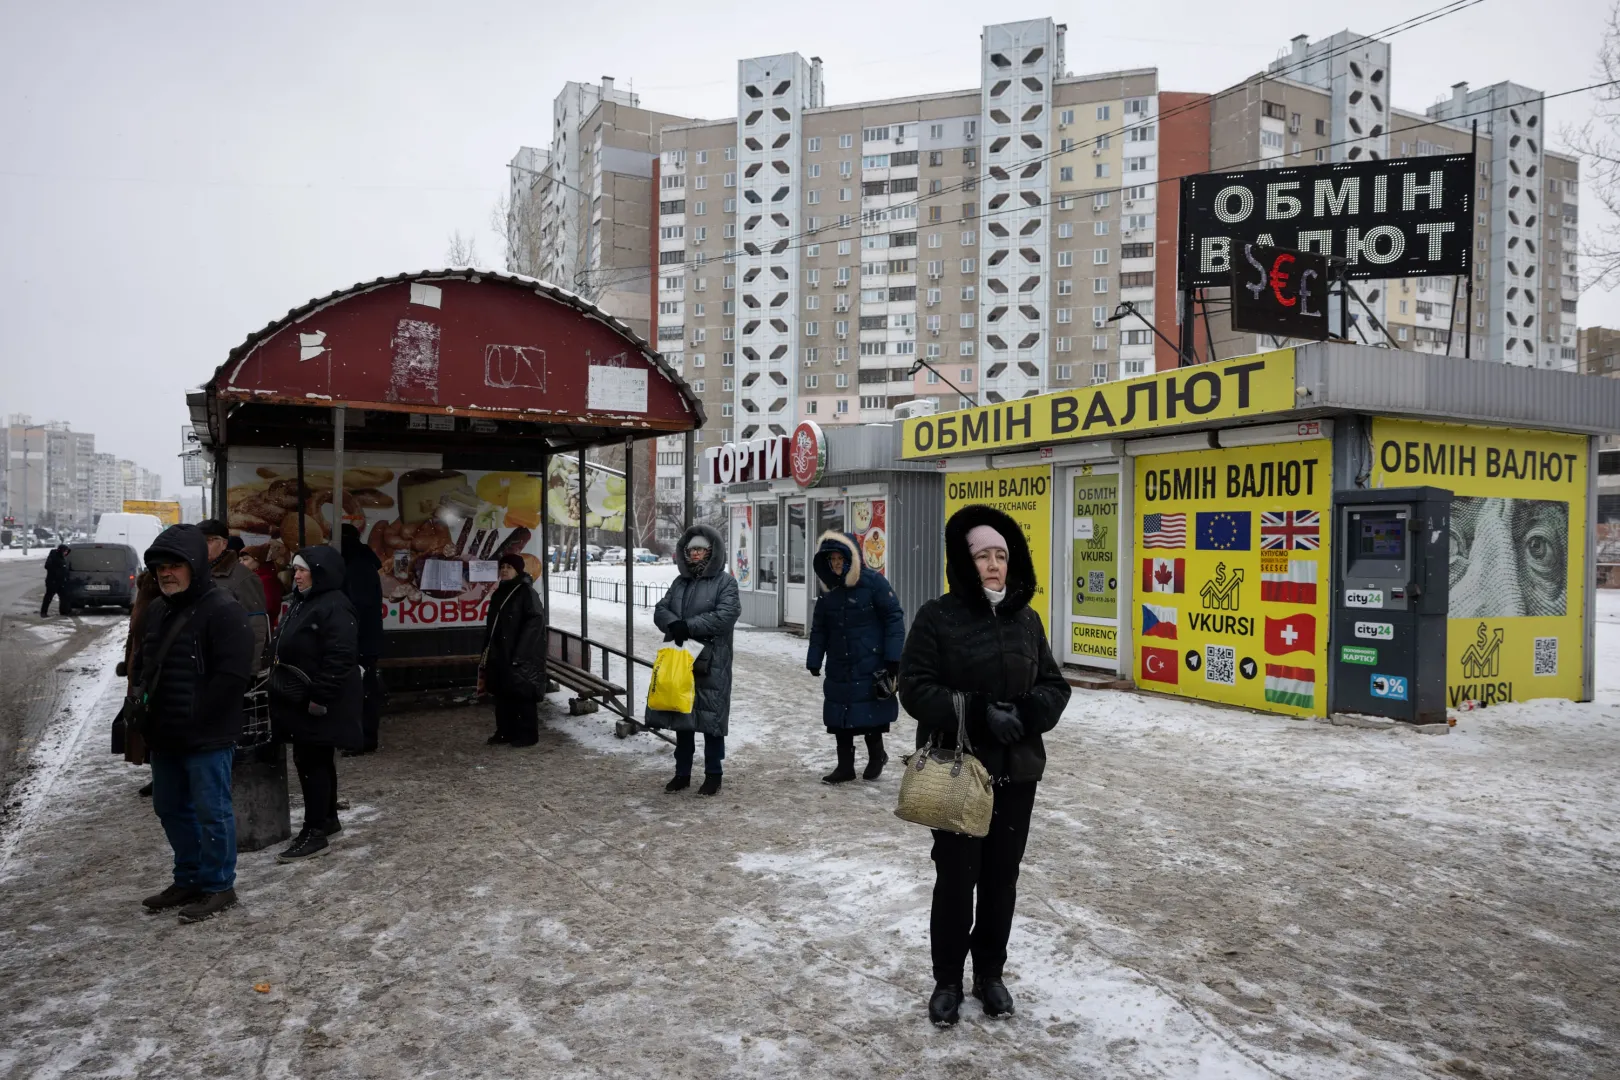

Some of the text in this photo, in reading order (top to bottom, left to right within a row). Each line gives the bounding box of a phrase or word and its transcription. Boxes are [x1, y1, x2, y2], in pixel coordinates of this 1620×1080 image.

[1214, 170, 1443, 223] ОБМІН
[914, 361, 1265, 451] ОБМІН ВАЛЮТ
[705, 435, 784, 485] ТОРТИ
[1381, 440, 1577, 483] ОБМІН ВАЛЮТ
[1145, 459, 1318, 502] ОБМІН ВАЛЮТ
[949, 479, 995, 500] ОБМІН
[1078, 487, 1117, 500] ОБМІН
[999, 501, 1037, 511] EXCHANGE
[1077, 503, 1118, 516] ВАЛЮТ
[1081, 551, 1113, 562] VKURSI
[1347, 592, 1382, 604] city24
[1188, 612, 1254, 636] VKURSI
[1357, 624, 1392, 636] city24
[1073, 626, 1117, 640] CURRENCY
[1073, 643, 1117, 657] EXCHANGE
[1343, 653, 1375, 663] КАРТКУ
[1449, 682, 1512, 707] VKURSI
